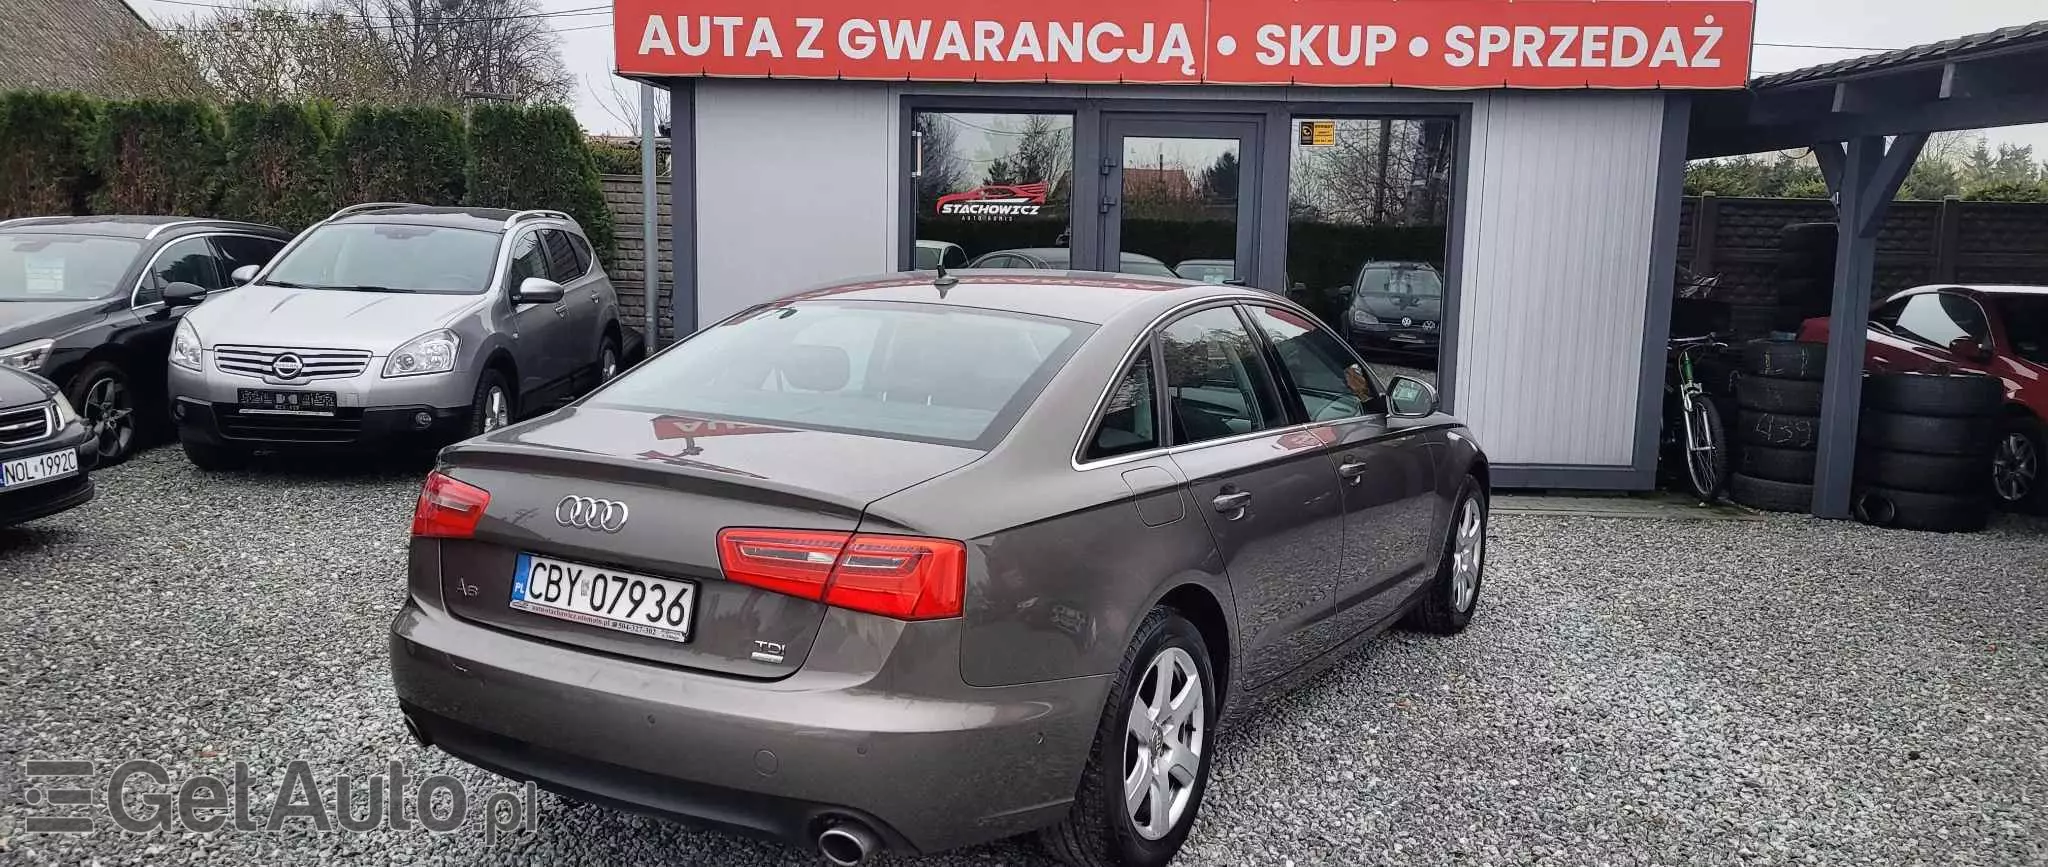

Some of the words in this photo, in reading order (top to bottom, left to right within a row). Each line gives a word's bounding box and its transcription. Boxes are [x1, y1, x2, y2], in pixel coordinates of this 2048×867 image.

[638, 15, 783, 58] AUTA
[796, 17, 824, 59] Z
[838, 18, 1196, 76] GWARANCJĄ
[1255, 24, 1397, 67] SKUP
[1444, 14, 1724, 68] SPRZEDAŻ
[941, 203, 1041, 216] STACHOWICZ
[4, 460, 35, 485] NOL
[40, 451, 76, 480] 1992C
[514, 583, 525, 594] PL
[528, 561, 583, 607] CBY
[589, 572, 689, 627] 07936
[754, 640, 786, 655] TDI
